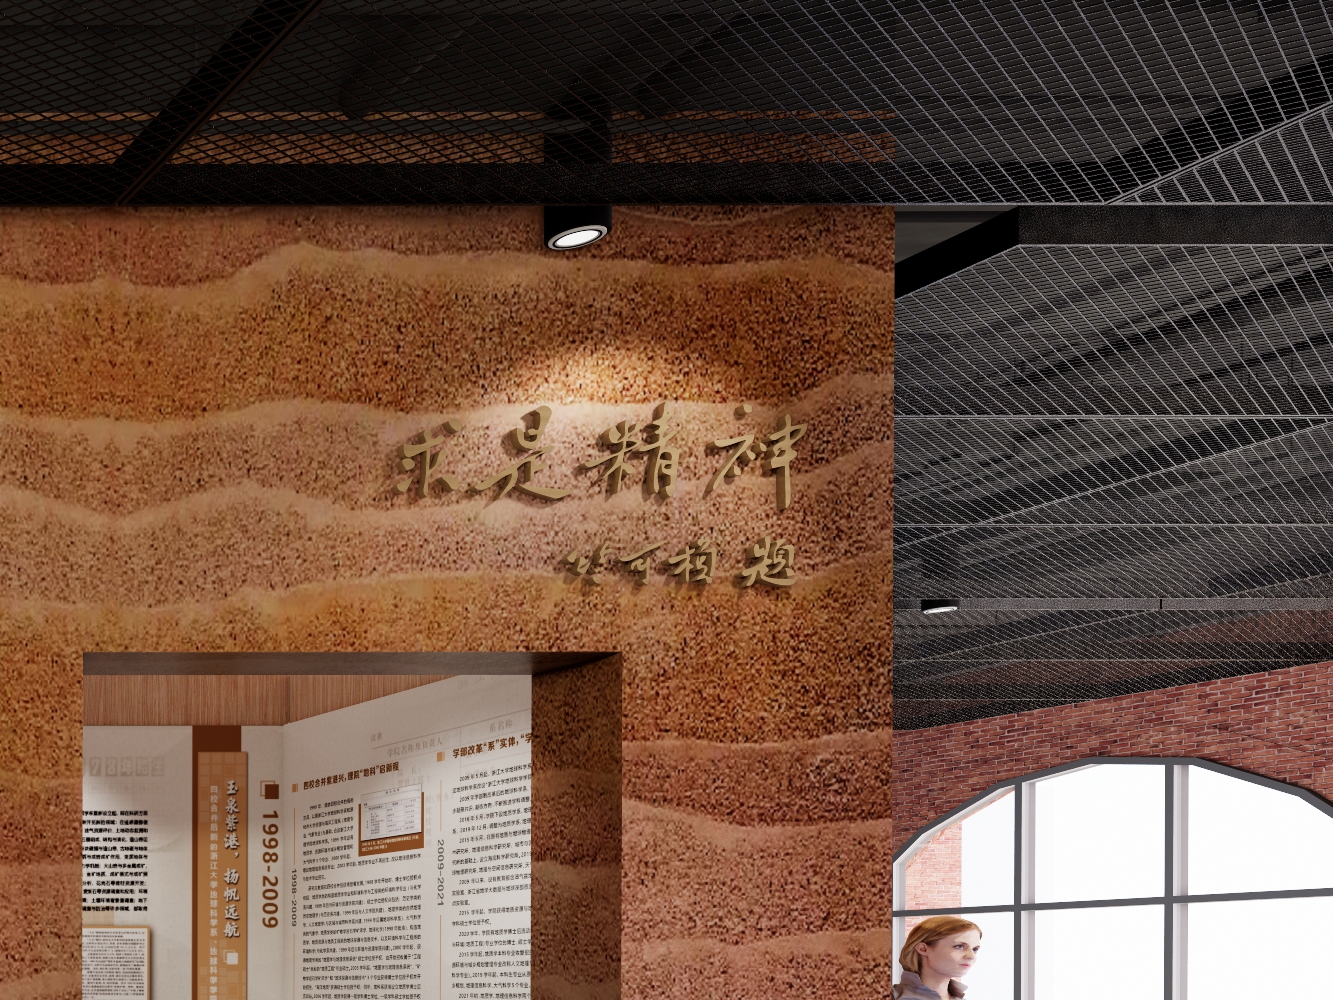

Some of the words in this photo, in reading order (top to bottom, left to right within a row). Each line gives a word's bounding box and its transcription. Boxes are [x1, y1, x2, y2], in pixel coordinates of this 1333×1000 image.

[391, 401, 808, 510] 求是精神
[262, 810, 279, 929] 1998-2009
